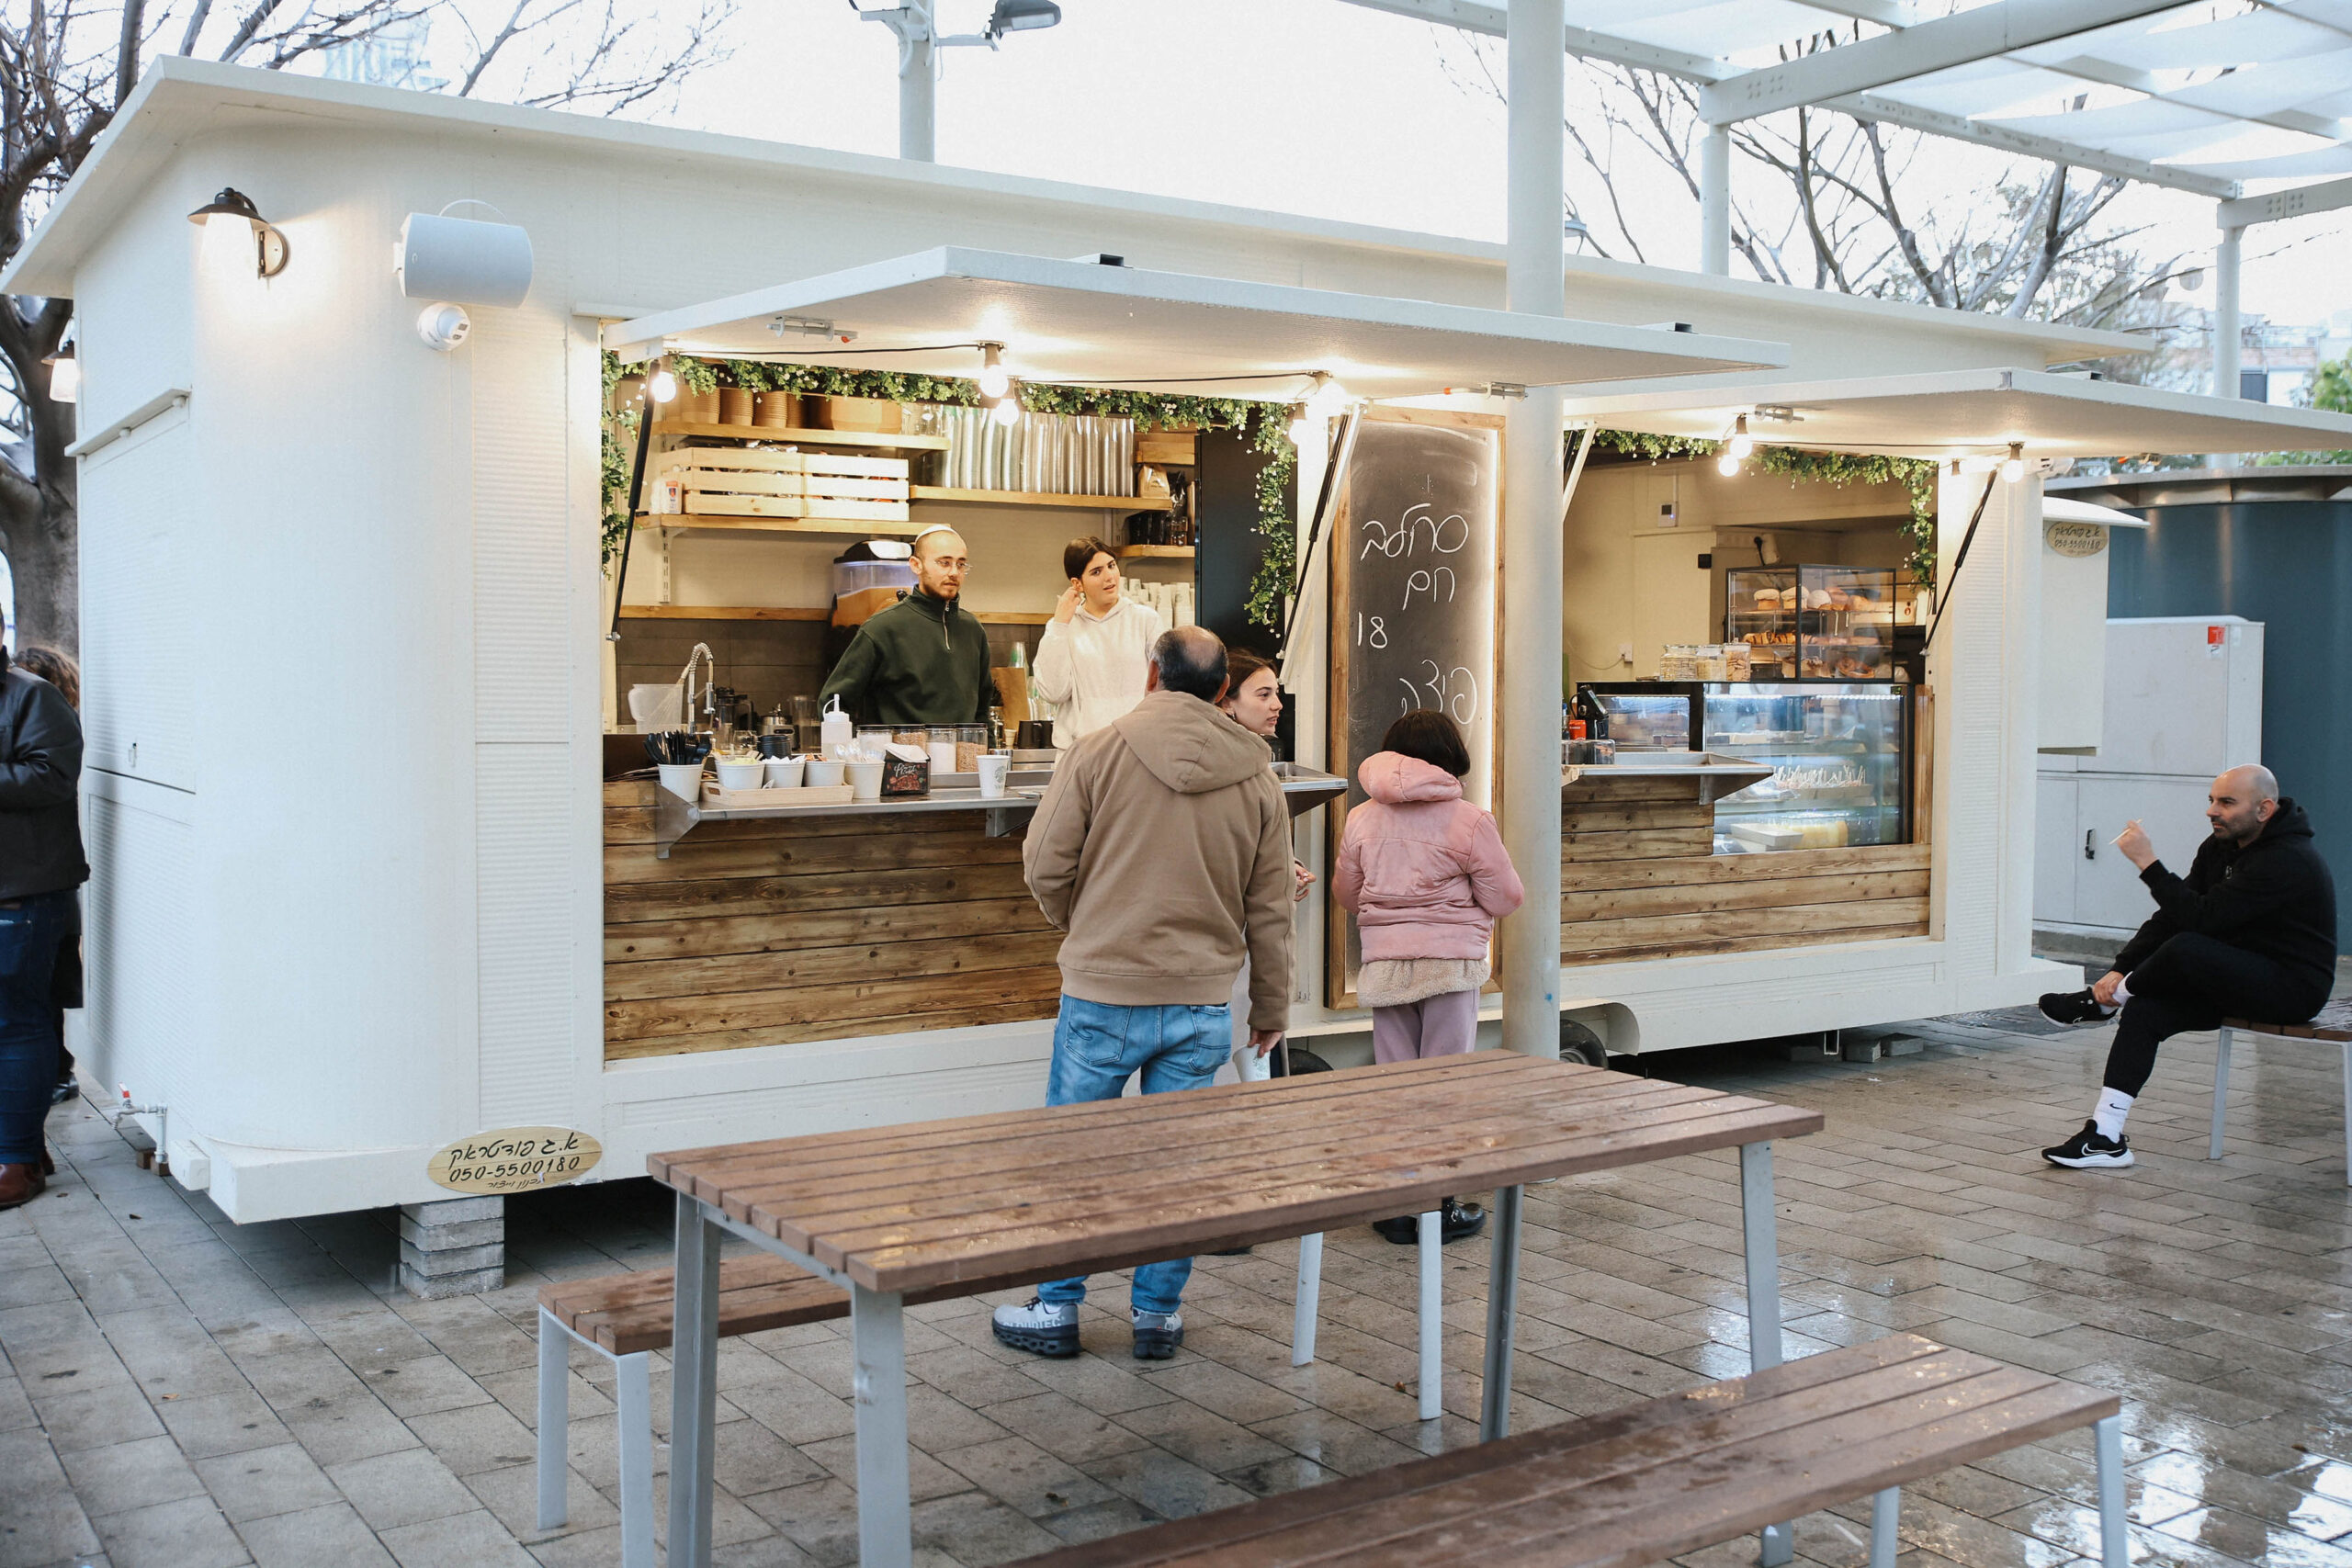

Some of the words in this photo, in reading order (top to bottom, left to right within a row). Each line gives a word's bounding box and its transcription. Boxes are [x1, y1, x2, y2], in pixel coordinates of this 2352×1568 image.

[1360, 503, 1469, 561] סחלב
[1402, 566, 1455, 611] חם
[1357, 611, 1388, 649] 18
[1398, 659, 1478, 725] פיצה
[447, 1138, 536, 1171] פודטראק
[448, 1156, 581, 1183] 050-5500180
